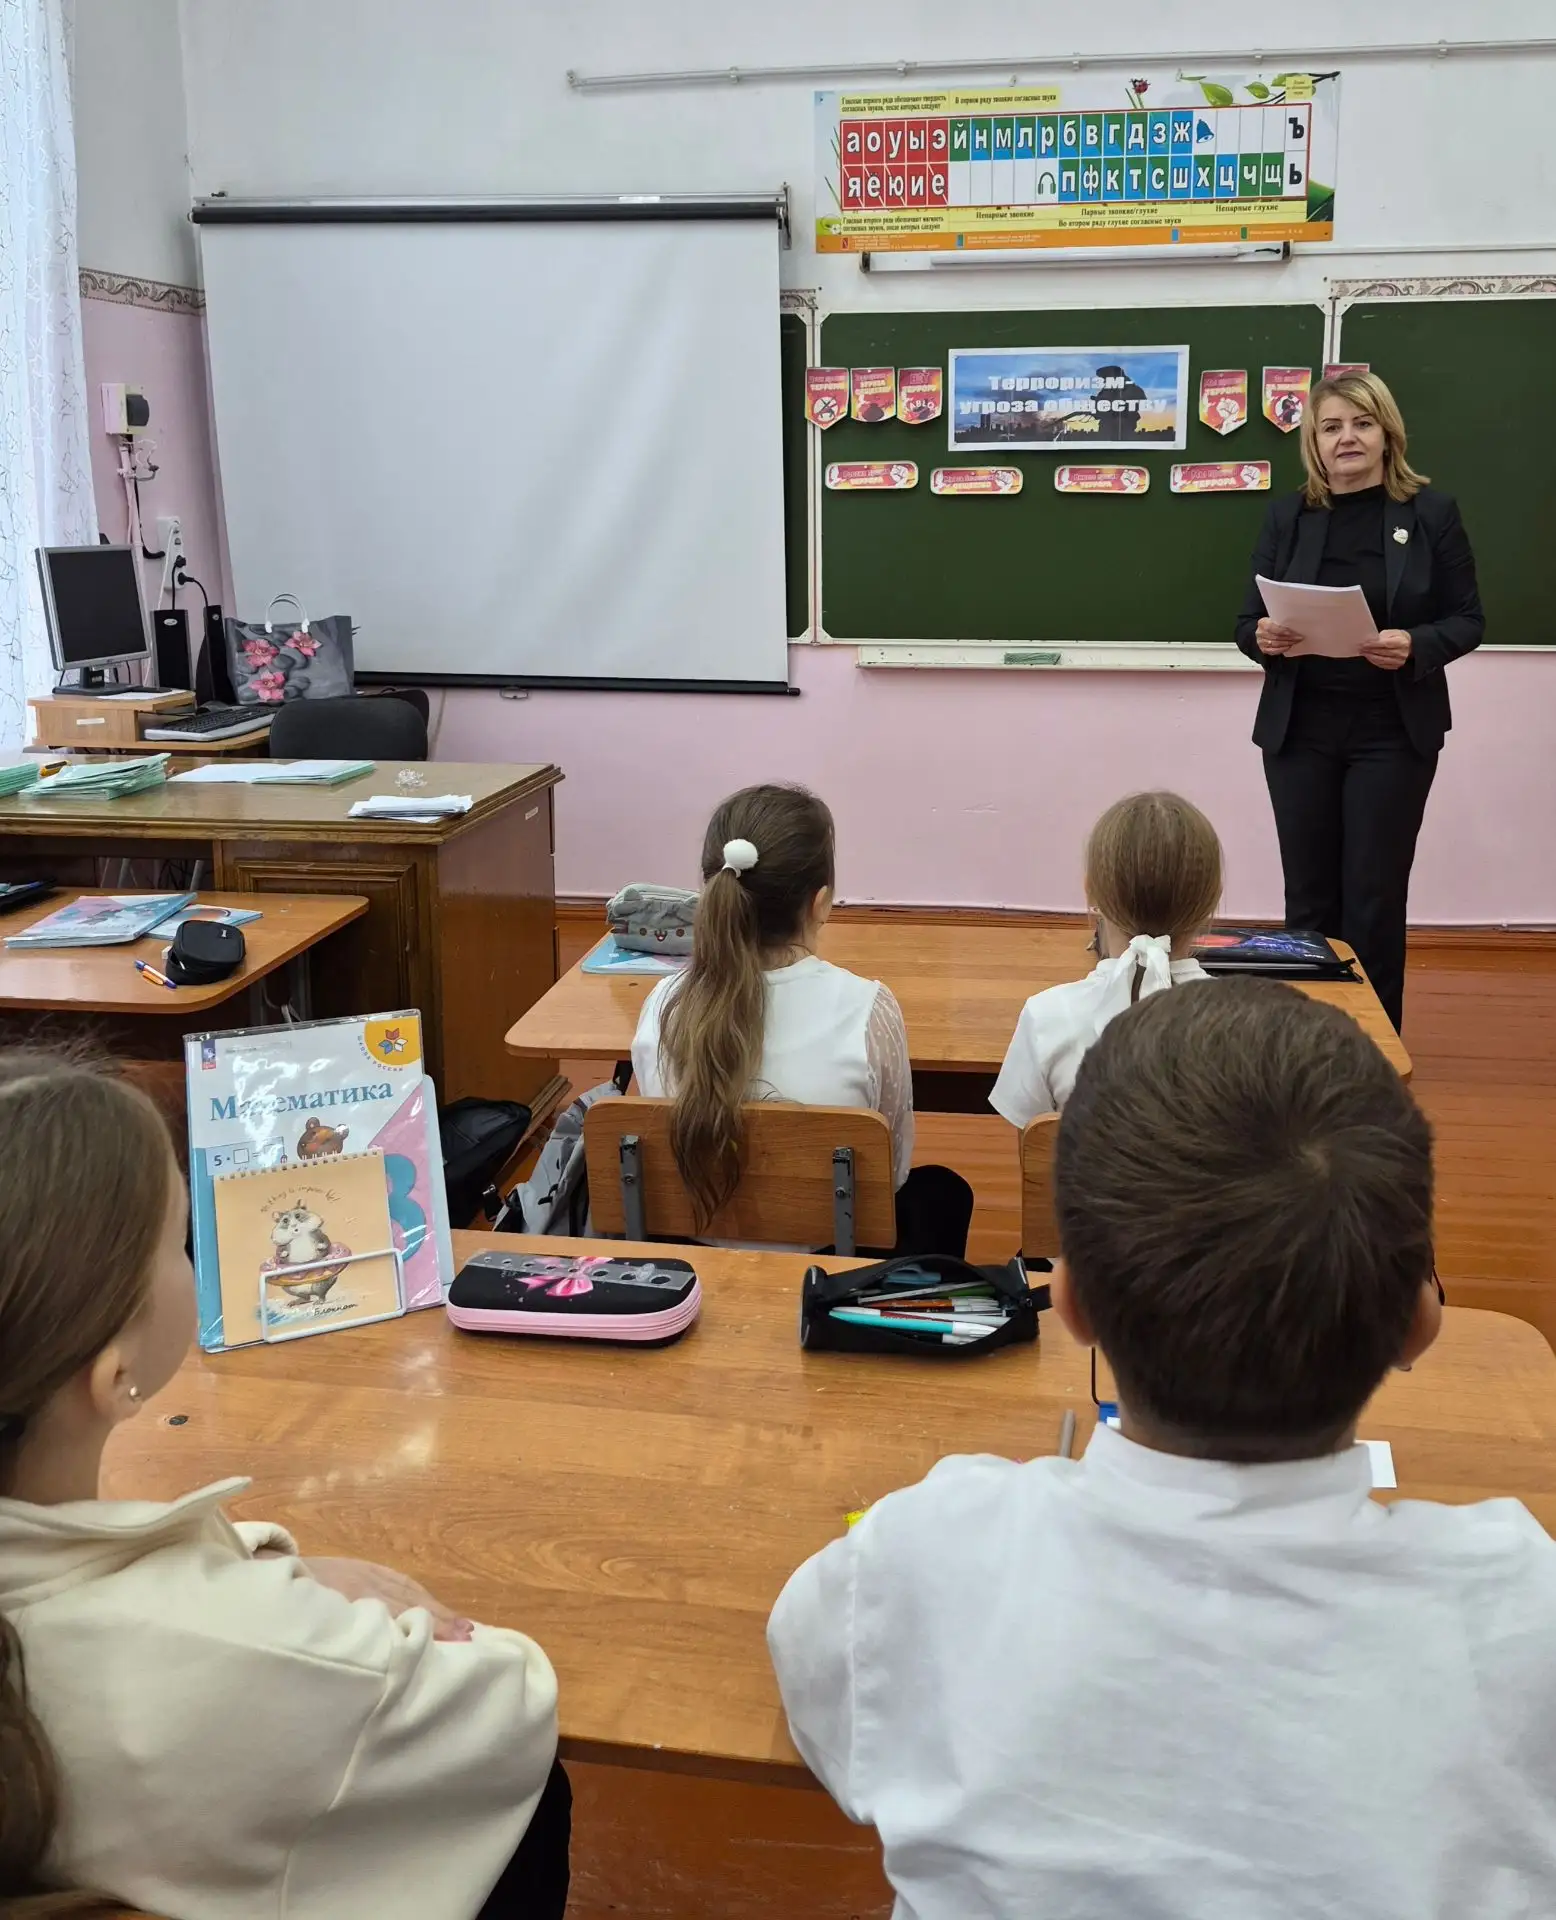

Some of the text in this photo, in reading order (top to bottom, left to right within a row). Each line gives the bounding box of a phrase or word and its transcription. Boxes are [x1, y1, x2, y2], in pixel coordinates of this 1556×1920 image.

[1081, 208, 1106, 217] Парные
[1216, 204, 1278, 213] Непарные глухие
[976, 211, 1007, 220] Непарные
[1068, 220, 1090, 228] втором
[1092, 219, 1105, 228] ряду
[1107, 219, 1129, 228] глухие
[1130, 218, 1162, 226] согласные
[1164, 217, 1181, 226] звуки
[959, 398, 1168, 415] угроза обществу
[210, 1082, 393, 1121] Мематика
[213, 1154, 222, 1167] 5
[314, 1303, 358, 1317] Блокнот
